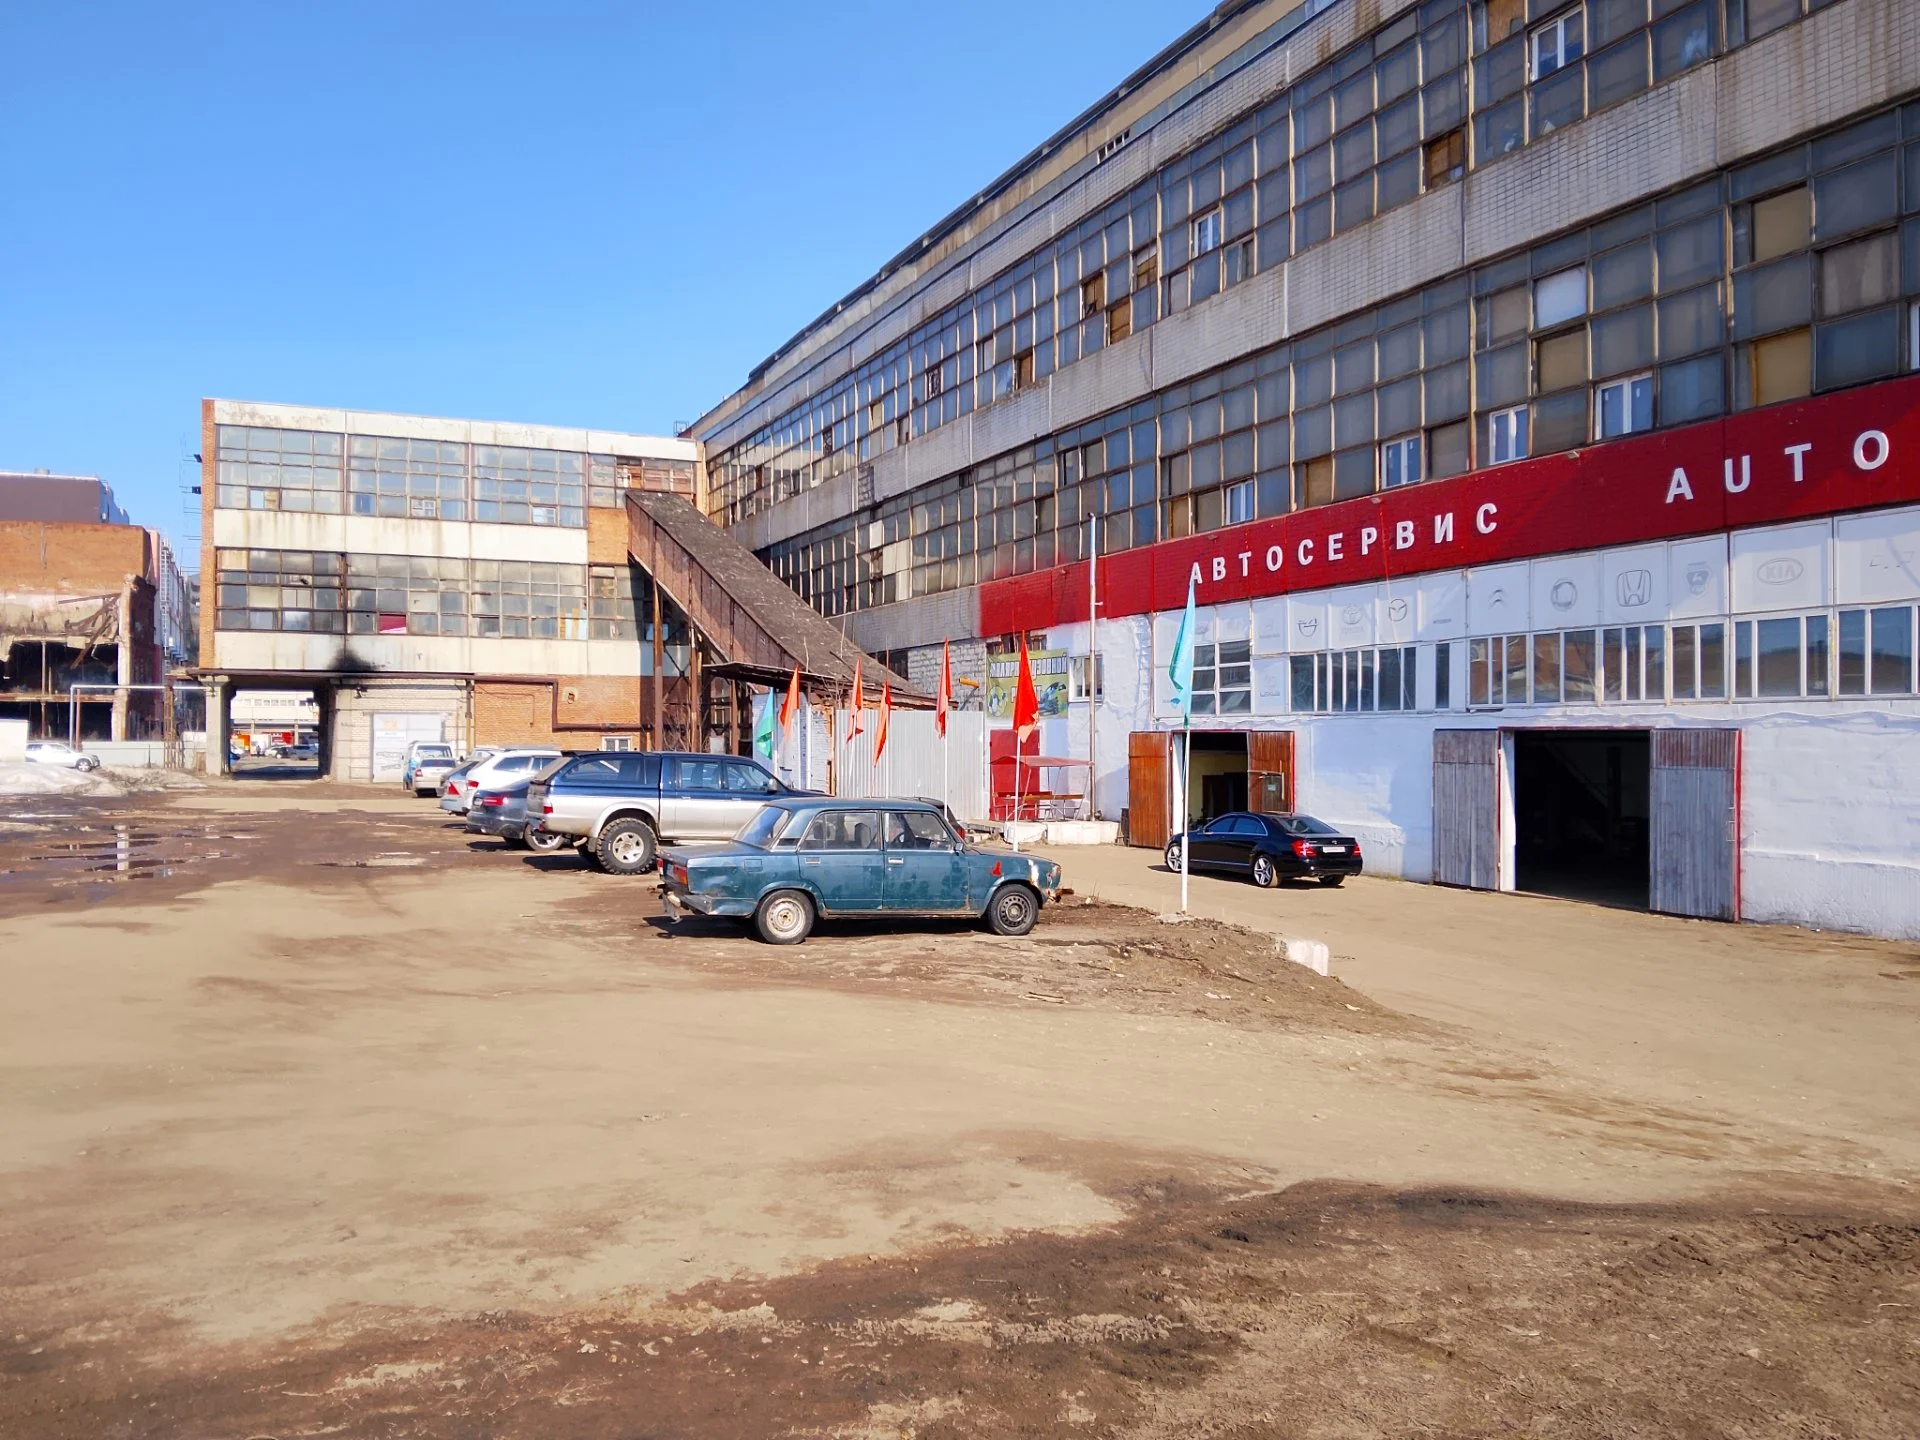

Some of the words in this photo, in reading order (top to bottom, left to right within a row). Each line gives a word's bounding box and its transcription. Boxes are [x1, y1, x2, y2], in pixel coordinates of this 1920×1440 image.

[1665, 430, 1889, 503] AUTO
[1190, 503, 1497, 584] АВТОСЕРВИС
[1765, 563, 1796, 581] KIA
